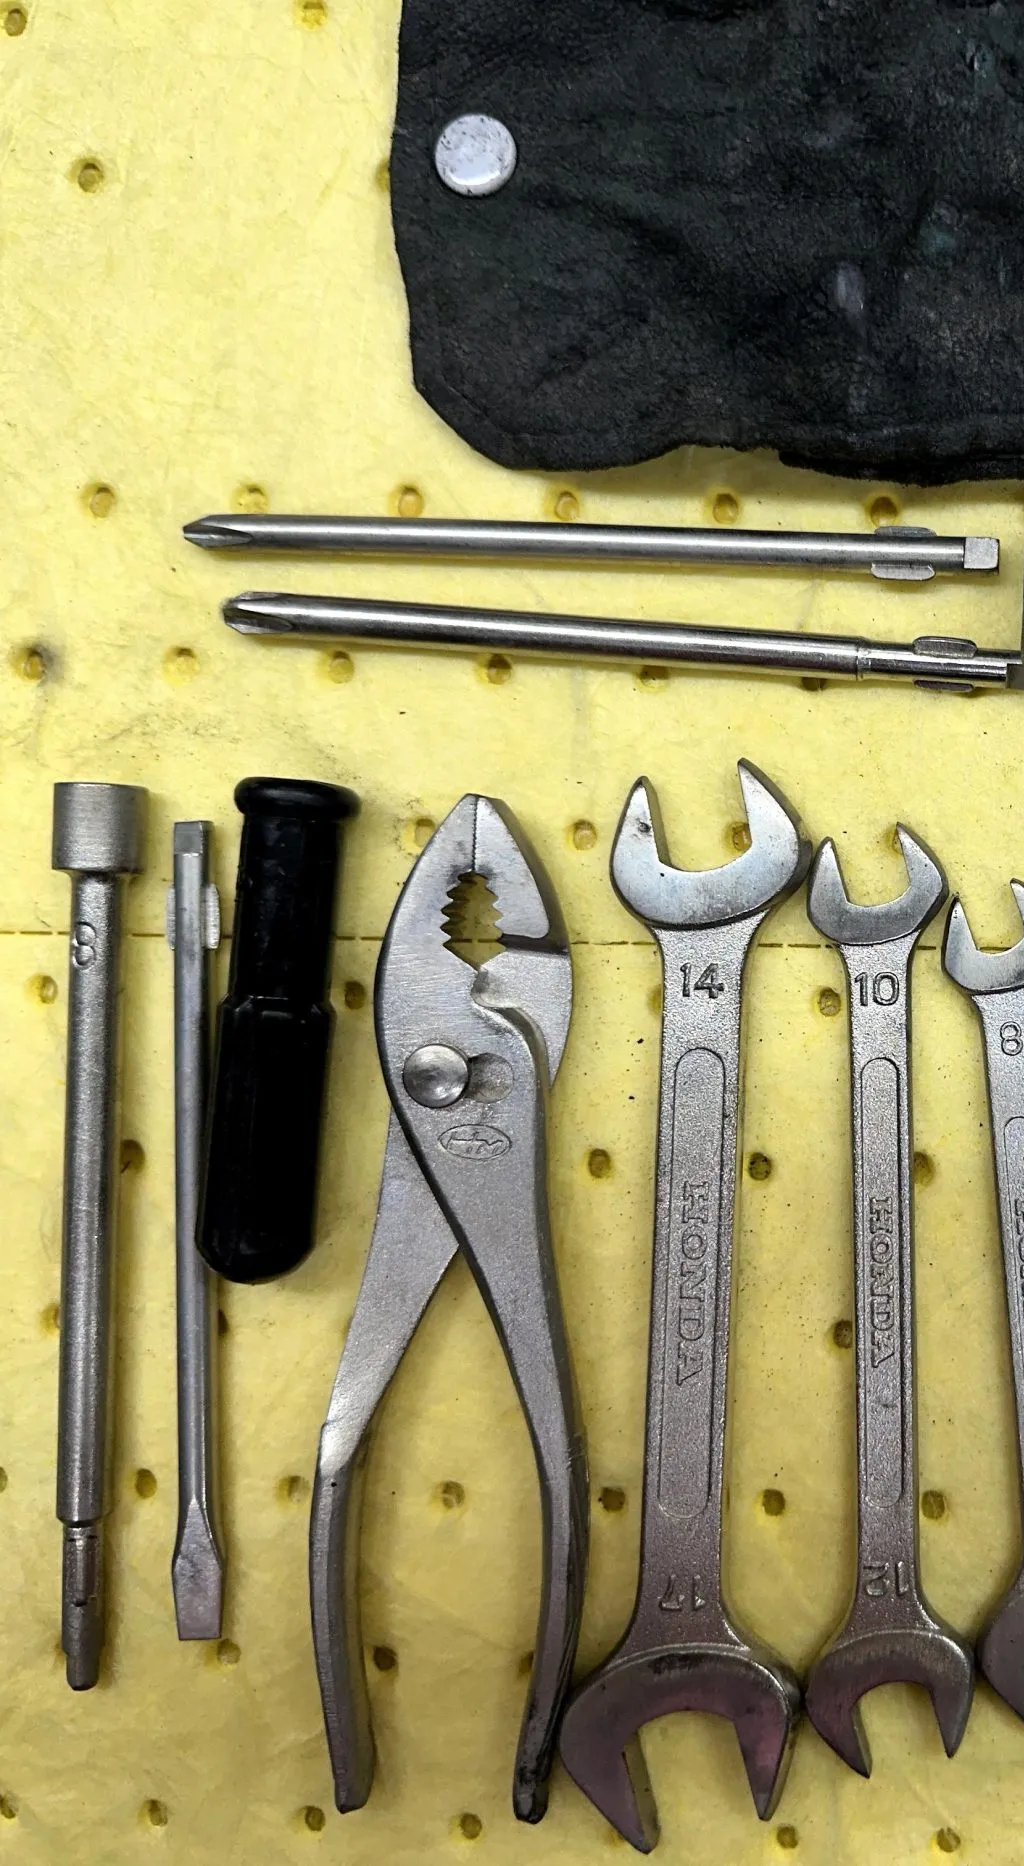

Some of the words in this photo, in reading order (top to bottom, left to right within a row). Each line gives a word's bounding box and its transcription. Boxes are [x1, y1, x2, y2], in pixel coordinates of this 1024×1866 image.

[679, 961, 724, 999] 14
[855, 972, 899, 1007] 10
[999, 1022, 1023, 1057] 8
[675, 1180, 710, 1387] HONDA
[869, 1196, 897, 1369] HONDA
[658, 1573, 706, 1612] 17
[863, 1560, 909, 1598] 12
